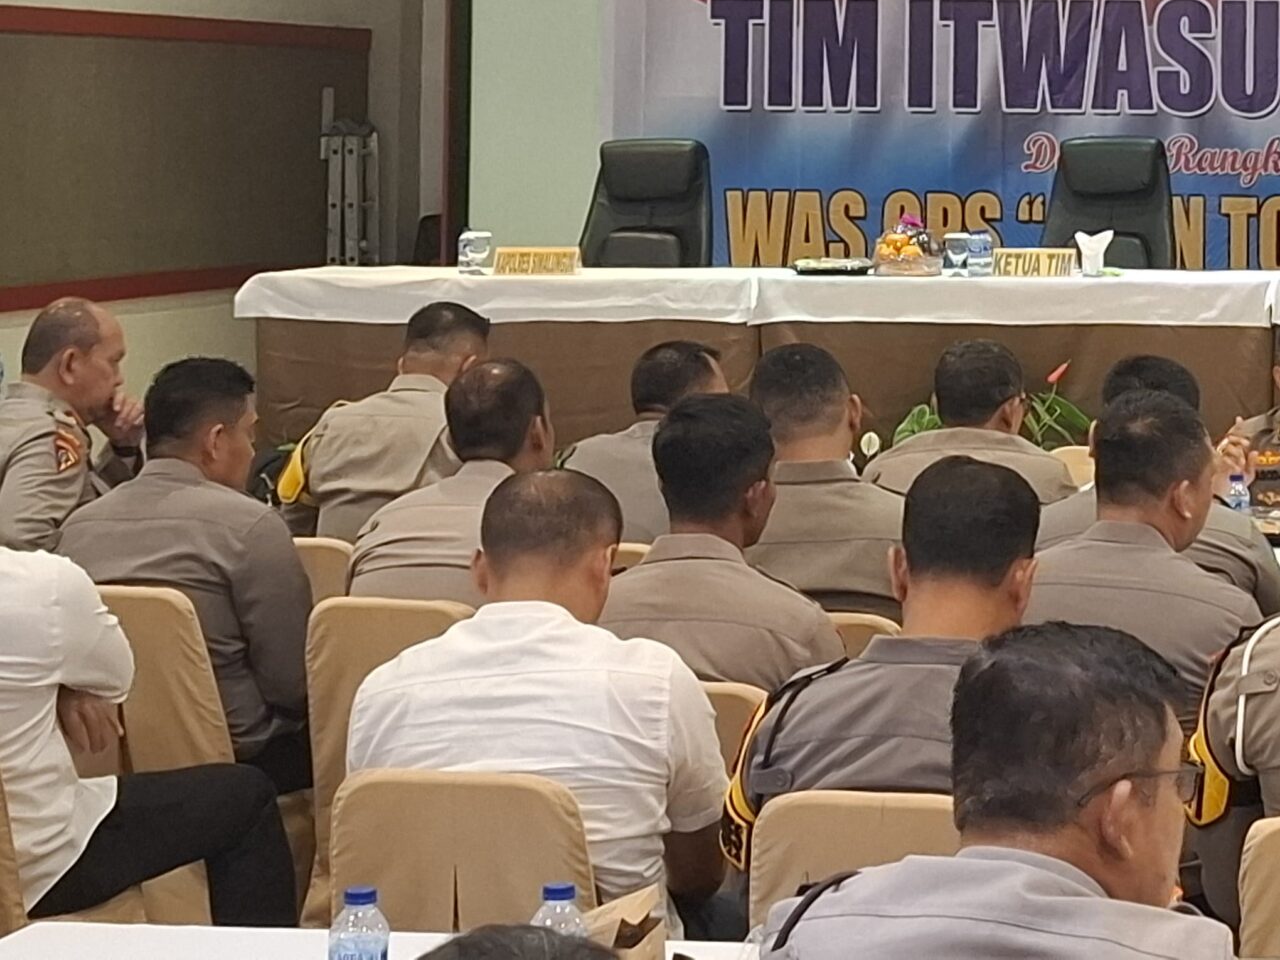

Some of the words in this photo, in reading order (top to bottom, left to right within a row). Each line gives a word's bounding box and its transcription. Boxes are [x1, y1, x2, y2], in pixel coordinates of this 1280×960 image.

[725, 189, 868, 268] WAS
[993, 253, 1041, 276] KETUA
[1046, 253, 1073, 276] TIM
